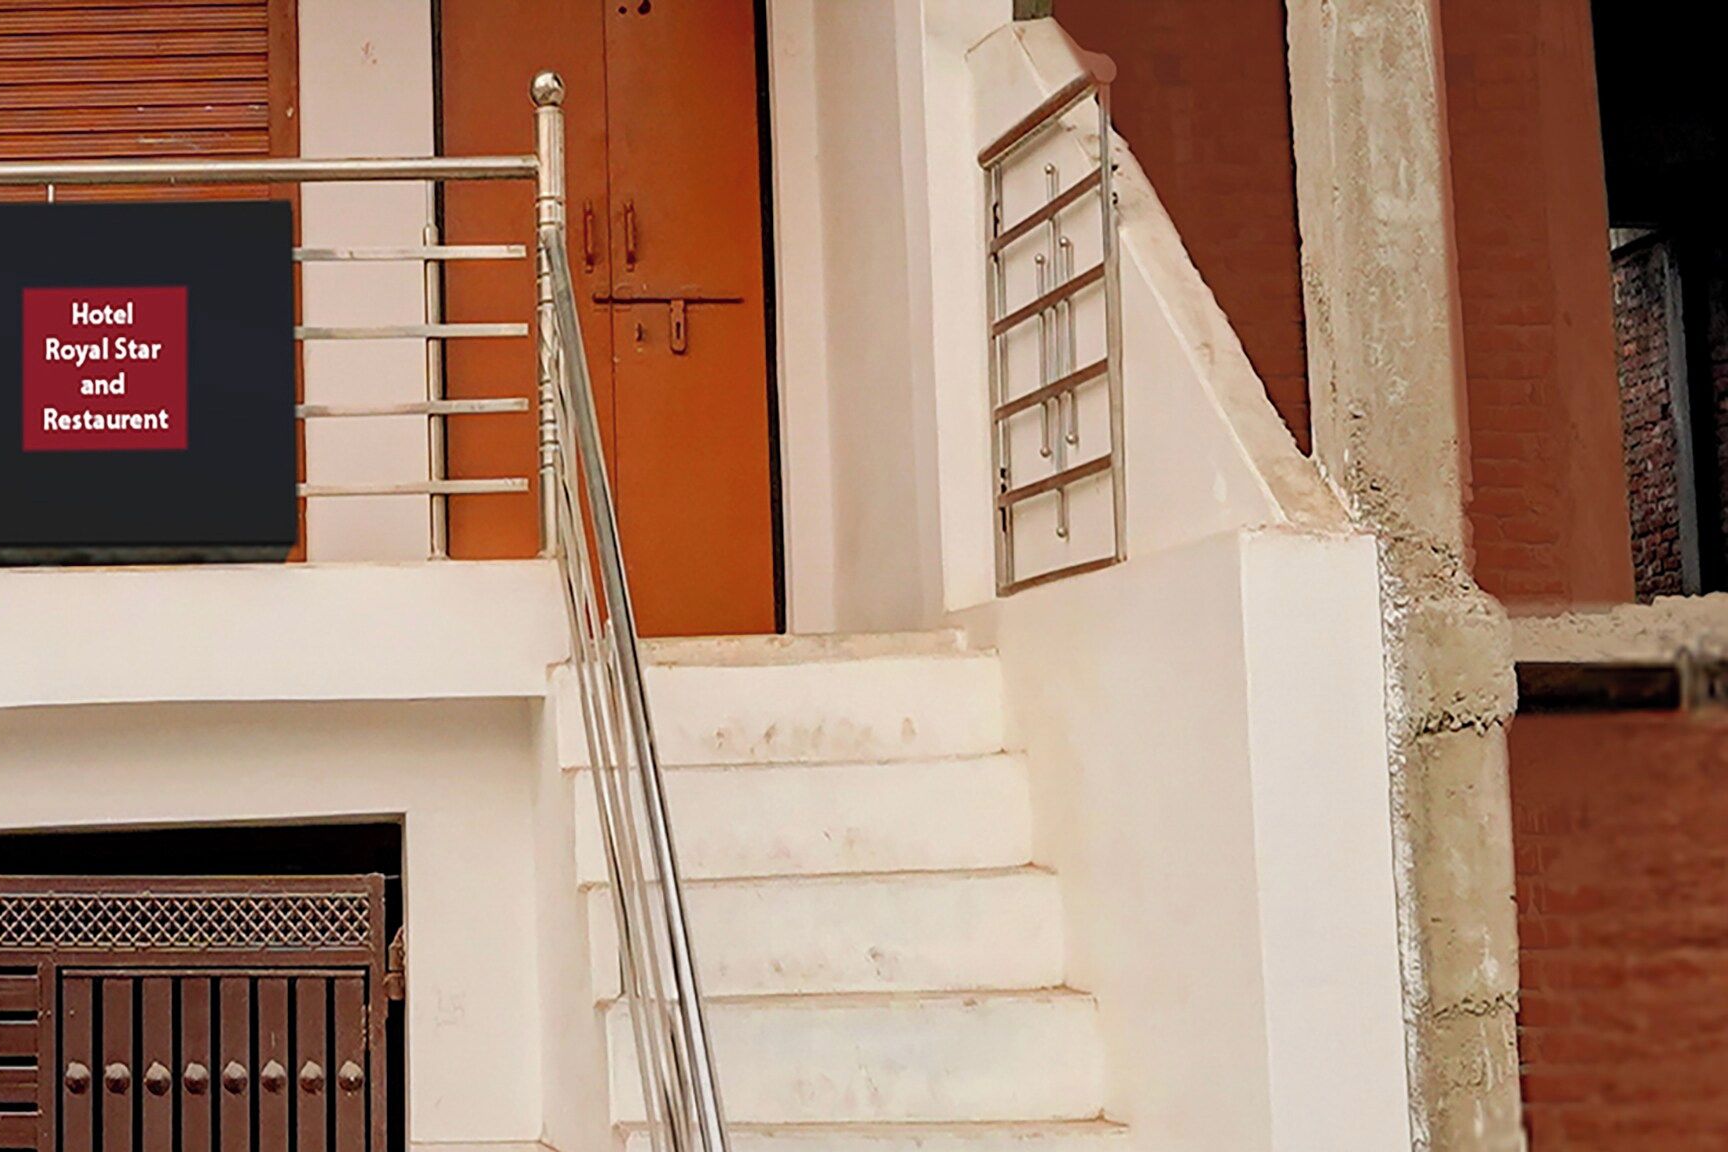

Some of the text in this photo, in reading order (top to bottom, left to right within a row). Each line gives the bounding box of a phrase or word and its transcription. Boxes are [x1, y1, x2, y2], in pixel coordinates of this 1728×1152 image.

[72, 301, 133, 325] Hotel
[45, 336, 162, 367] Royal Star
[80, 371, 125, 395] and
[43, 407, 169, 431] Restaurent
